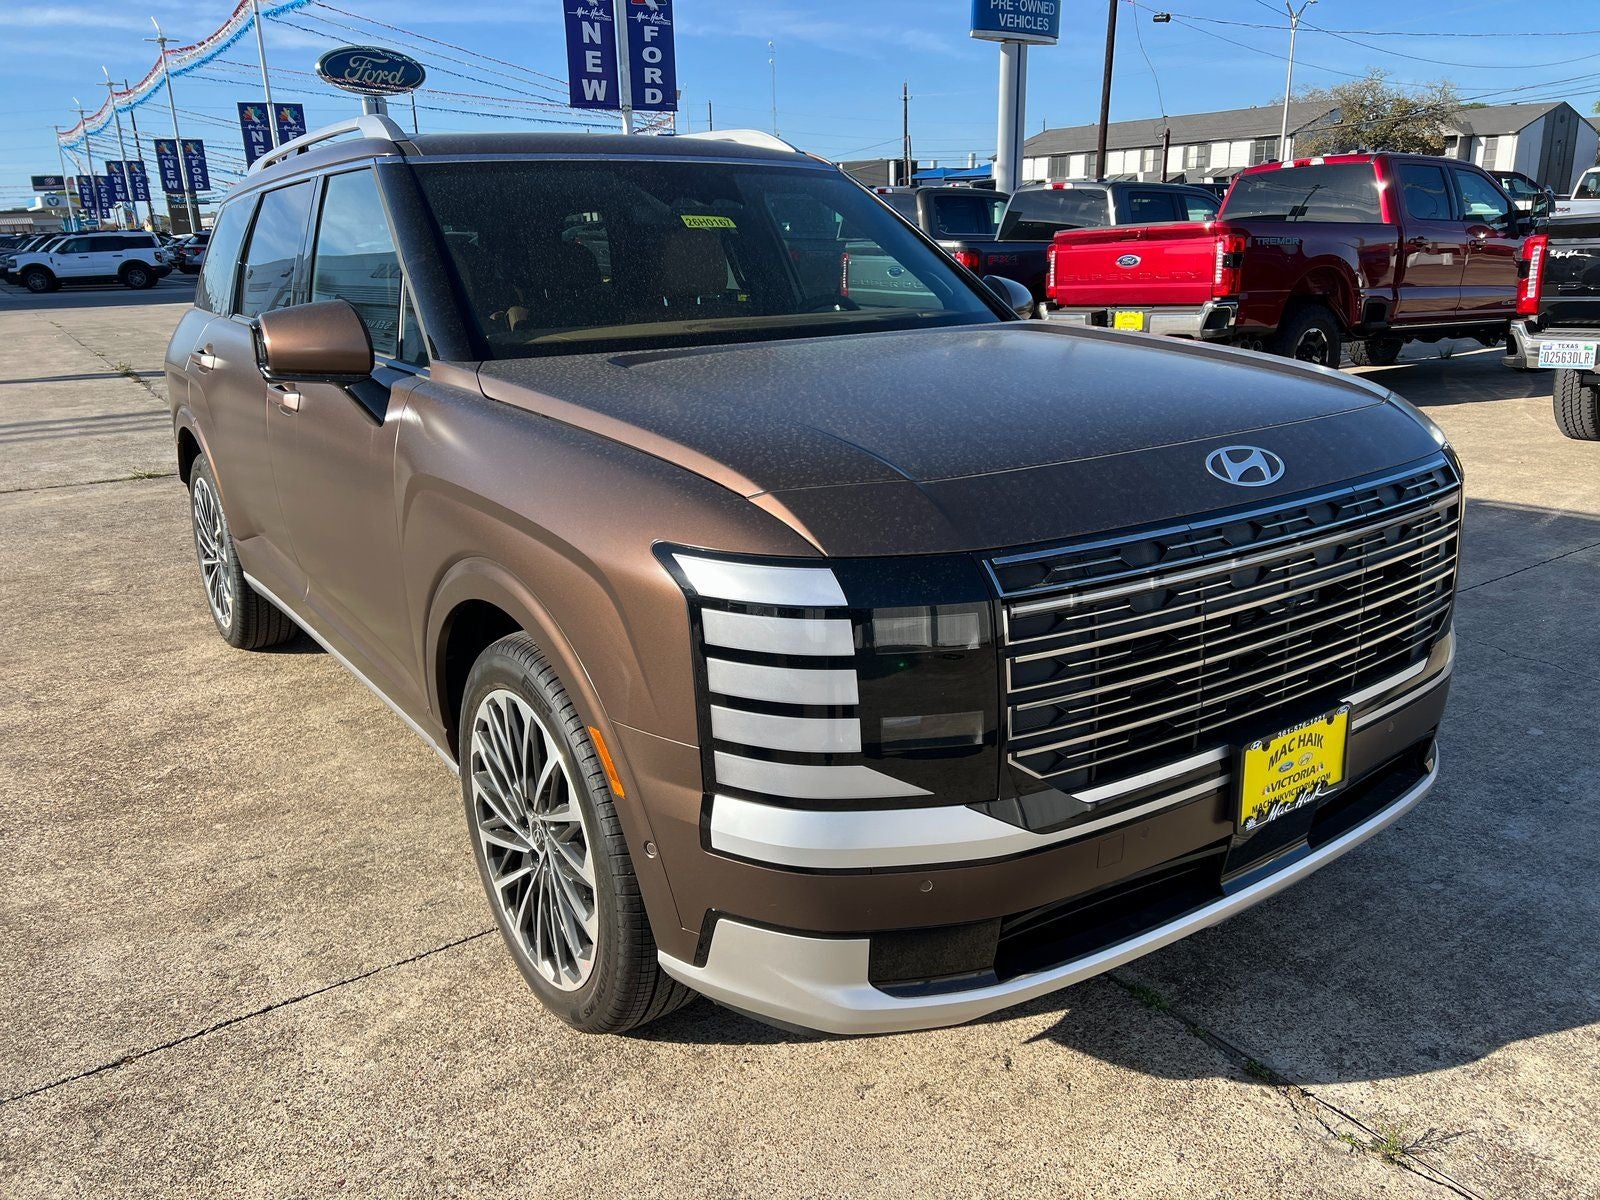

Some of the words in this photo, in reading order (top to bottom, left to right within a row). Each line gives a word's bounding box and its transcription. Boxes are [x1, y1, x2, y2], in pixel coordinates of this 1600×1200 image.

[990, 0, 1055, 15] PRE-OWNED
[998, 13, 1049, 31] VEHICLES
[344, 55, 405, 85] Ford
[581, 21, 607, 101] NEW
[642, 25, 664, 104] FORD
[251, 131, 266, 161] NE
[164, 159, 178, 189] NEW
[191, 160, 204, 189] FORD
[82, 188, 92, 207] NEW
[100, 188, 109, 207] FORD
[113, 176, 126, 200] NEW
[135, 176, 146, 200] FORD
[686, 218, 732, 228] 26H0167
[1255, 237, 1300, 245] TREMOR
[1063, 272, 1133, 282] SUPER
[1139, 271, 1202, 280] DUTY
[1544, 351, 1591, 364] 02563DLR
[1268, 737, 1296, 771] MAC
[1297, 732, 1324, 749] HAIK
[1270, 764, 1316, 792] VICTORIA
[1268, 801, 1295, 822] Mac
[1295, 783, 1326, 809] Haik
